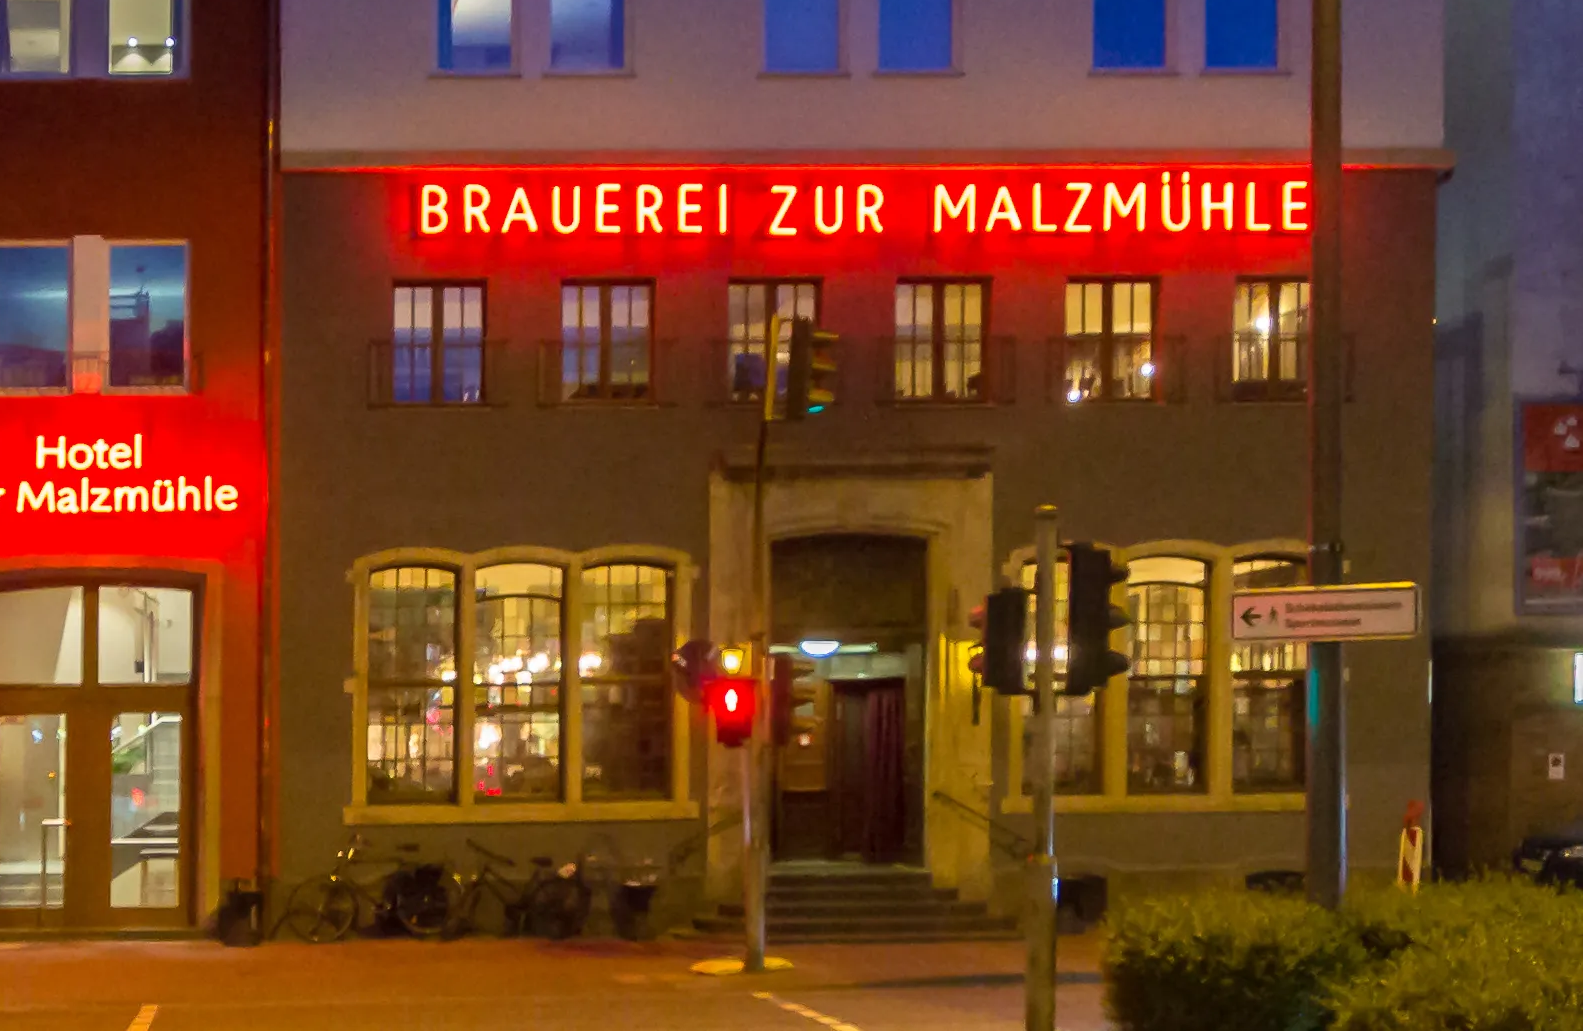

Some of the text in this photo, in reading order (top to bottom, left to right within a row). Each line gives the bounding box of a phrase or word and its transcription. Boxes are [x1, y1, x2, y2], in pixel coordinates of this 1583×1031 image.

[420, 171, 1310, 236] BRAUEREI ZUR MALZMÜHLE
[35, 433, 143, 471] Hotel
[15, 475, 239, 515] Malzmühle
